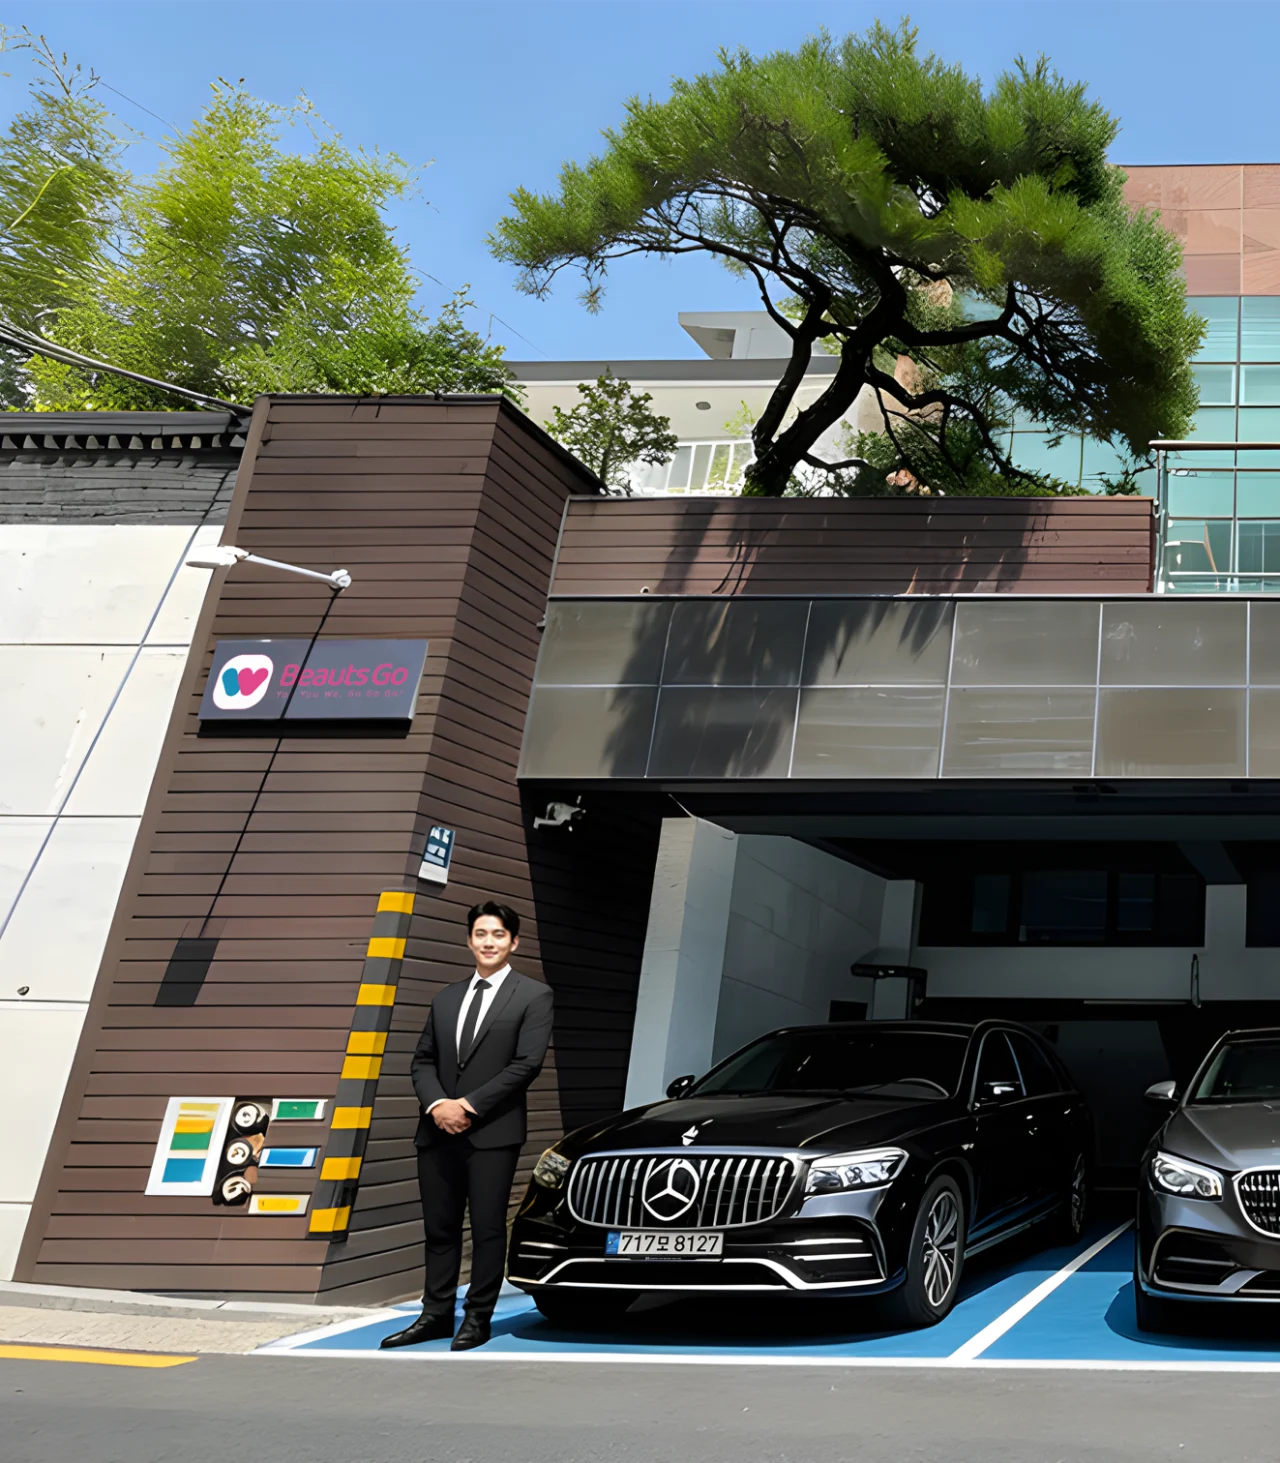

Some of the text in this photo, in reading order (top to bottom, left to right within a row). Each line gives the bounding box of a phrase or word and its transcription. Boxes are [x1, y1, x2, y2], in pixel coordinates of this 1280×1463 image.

[300, 690, 319, 699] You
[347, 689, 361, 698] Go
[366, 689, 380, 698] Go
[384, 689, 403, 698] Go!
[674, 1235, 720, 1252] 8127
